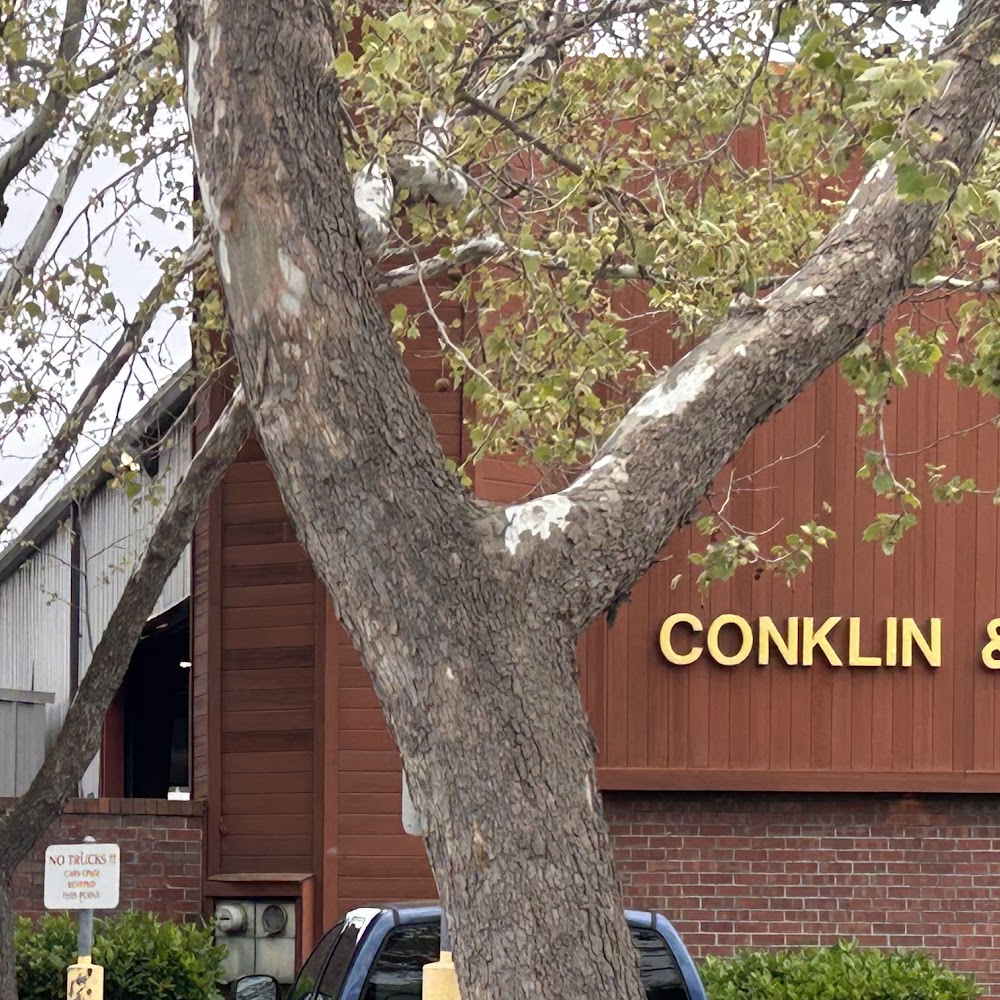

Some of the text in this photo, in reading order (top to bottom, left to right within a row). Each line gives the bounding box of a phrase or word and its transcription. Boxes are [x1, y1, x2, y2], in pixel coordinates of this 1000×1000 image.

[659, 612, 942, 667] CONKLIN
[49, 855, 65, 866] NO
[67, 853, 107, 866] TRUCKS
